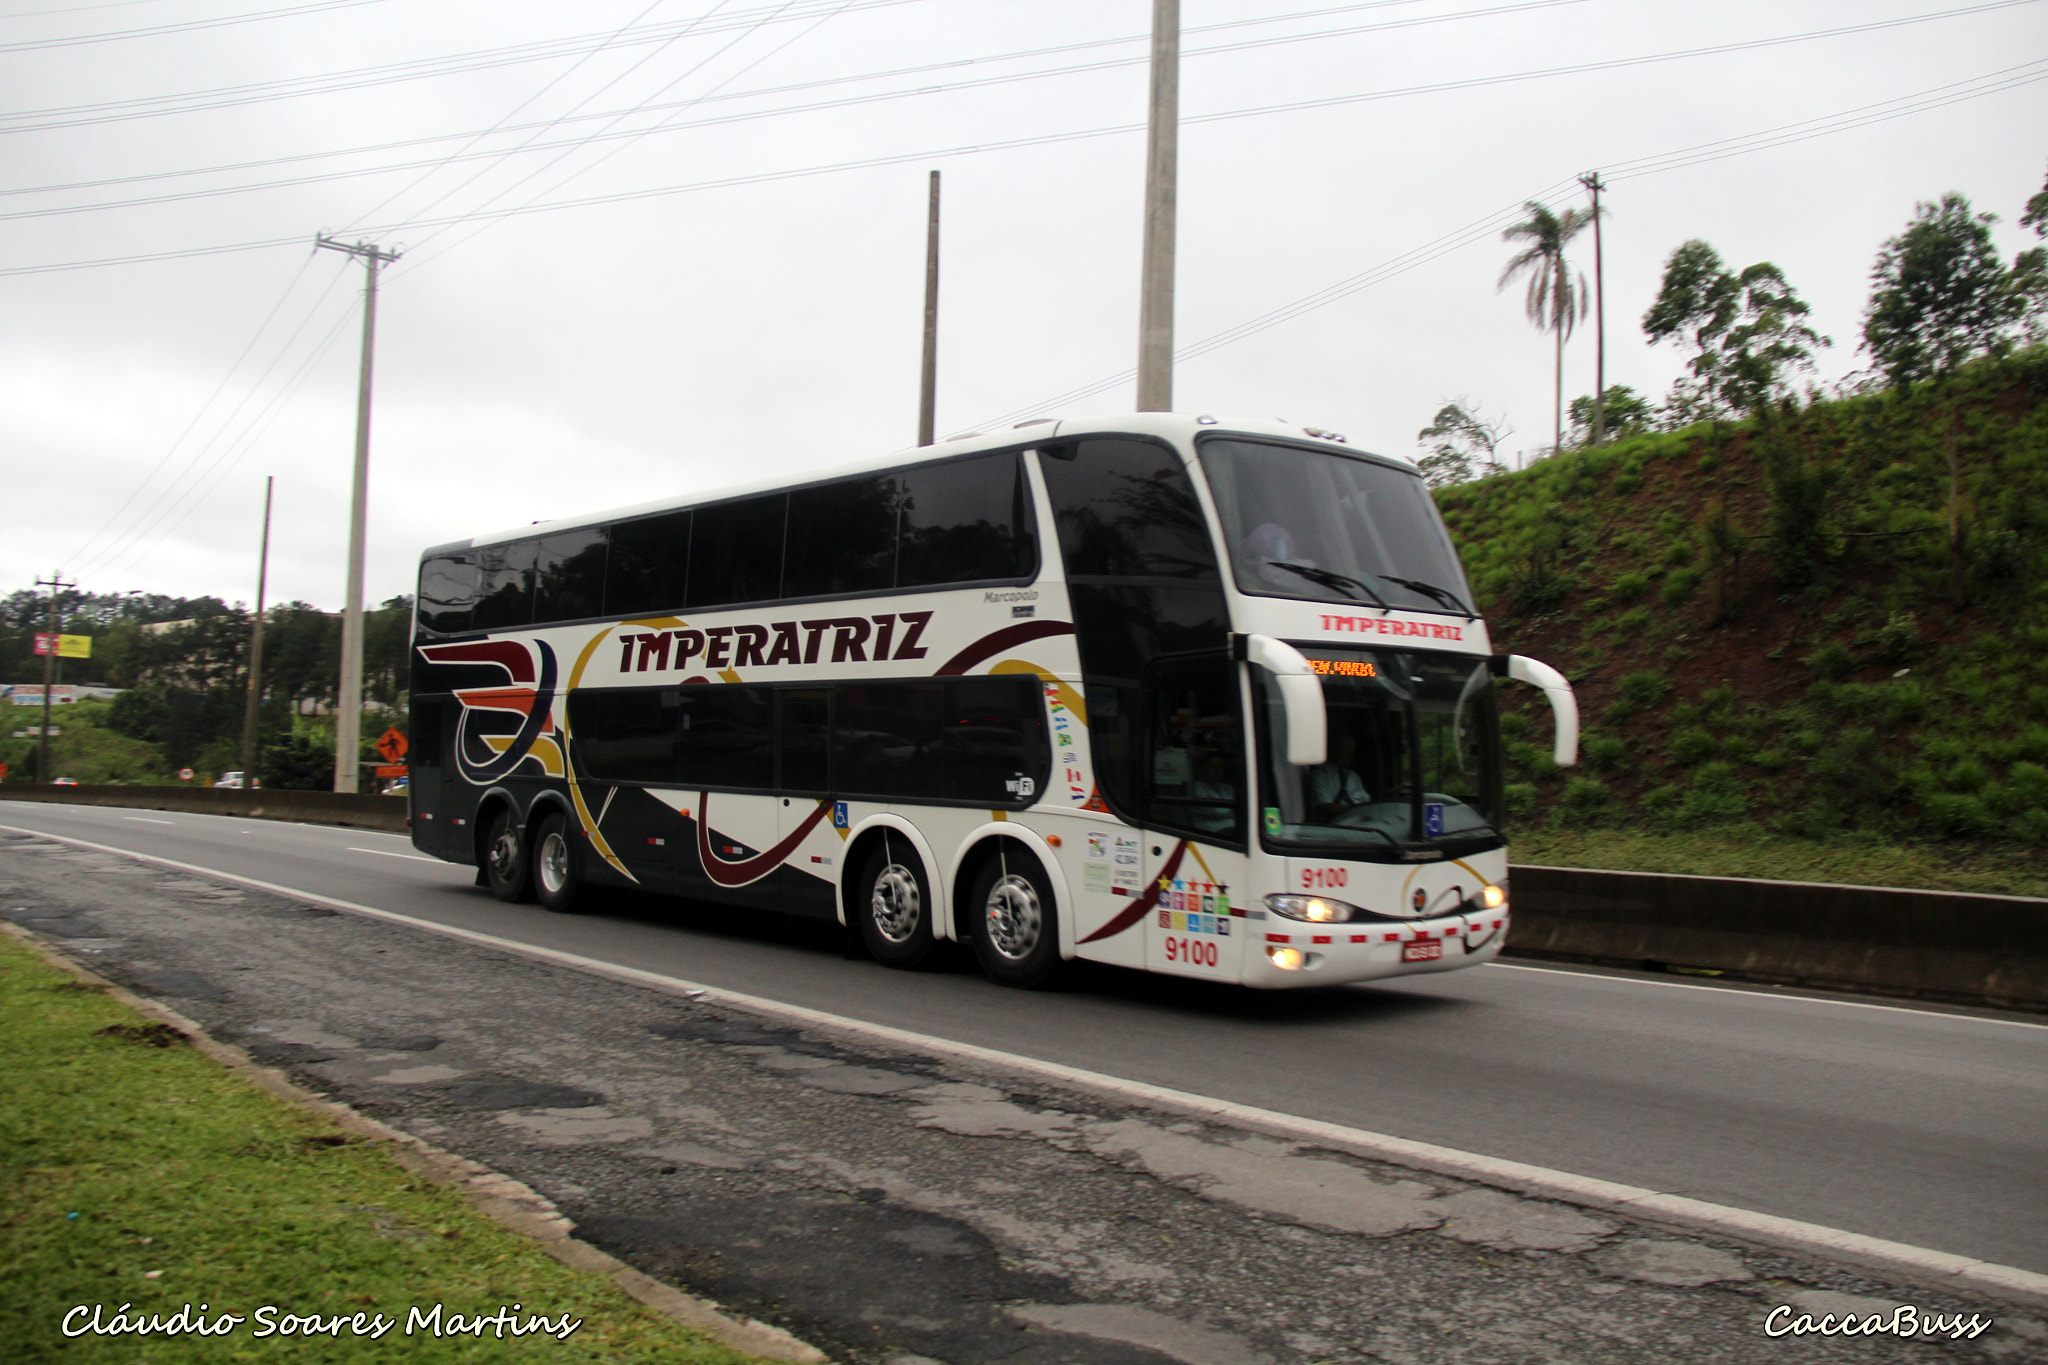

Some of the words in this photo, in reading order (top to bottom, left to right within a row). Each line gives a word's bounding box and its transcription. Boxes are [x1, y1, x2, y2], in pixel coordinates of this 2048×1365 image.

[983, 590, 1039, 603] Marcopolo
[1318, 614, 1464, 641] IMPERATRIZ
[619, 610, 934, 673] IMPERATRIZ
[1302, 867, 1348, 888] 9100
[1165, 936, 1218, 967] 9100
